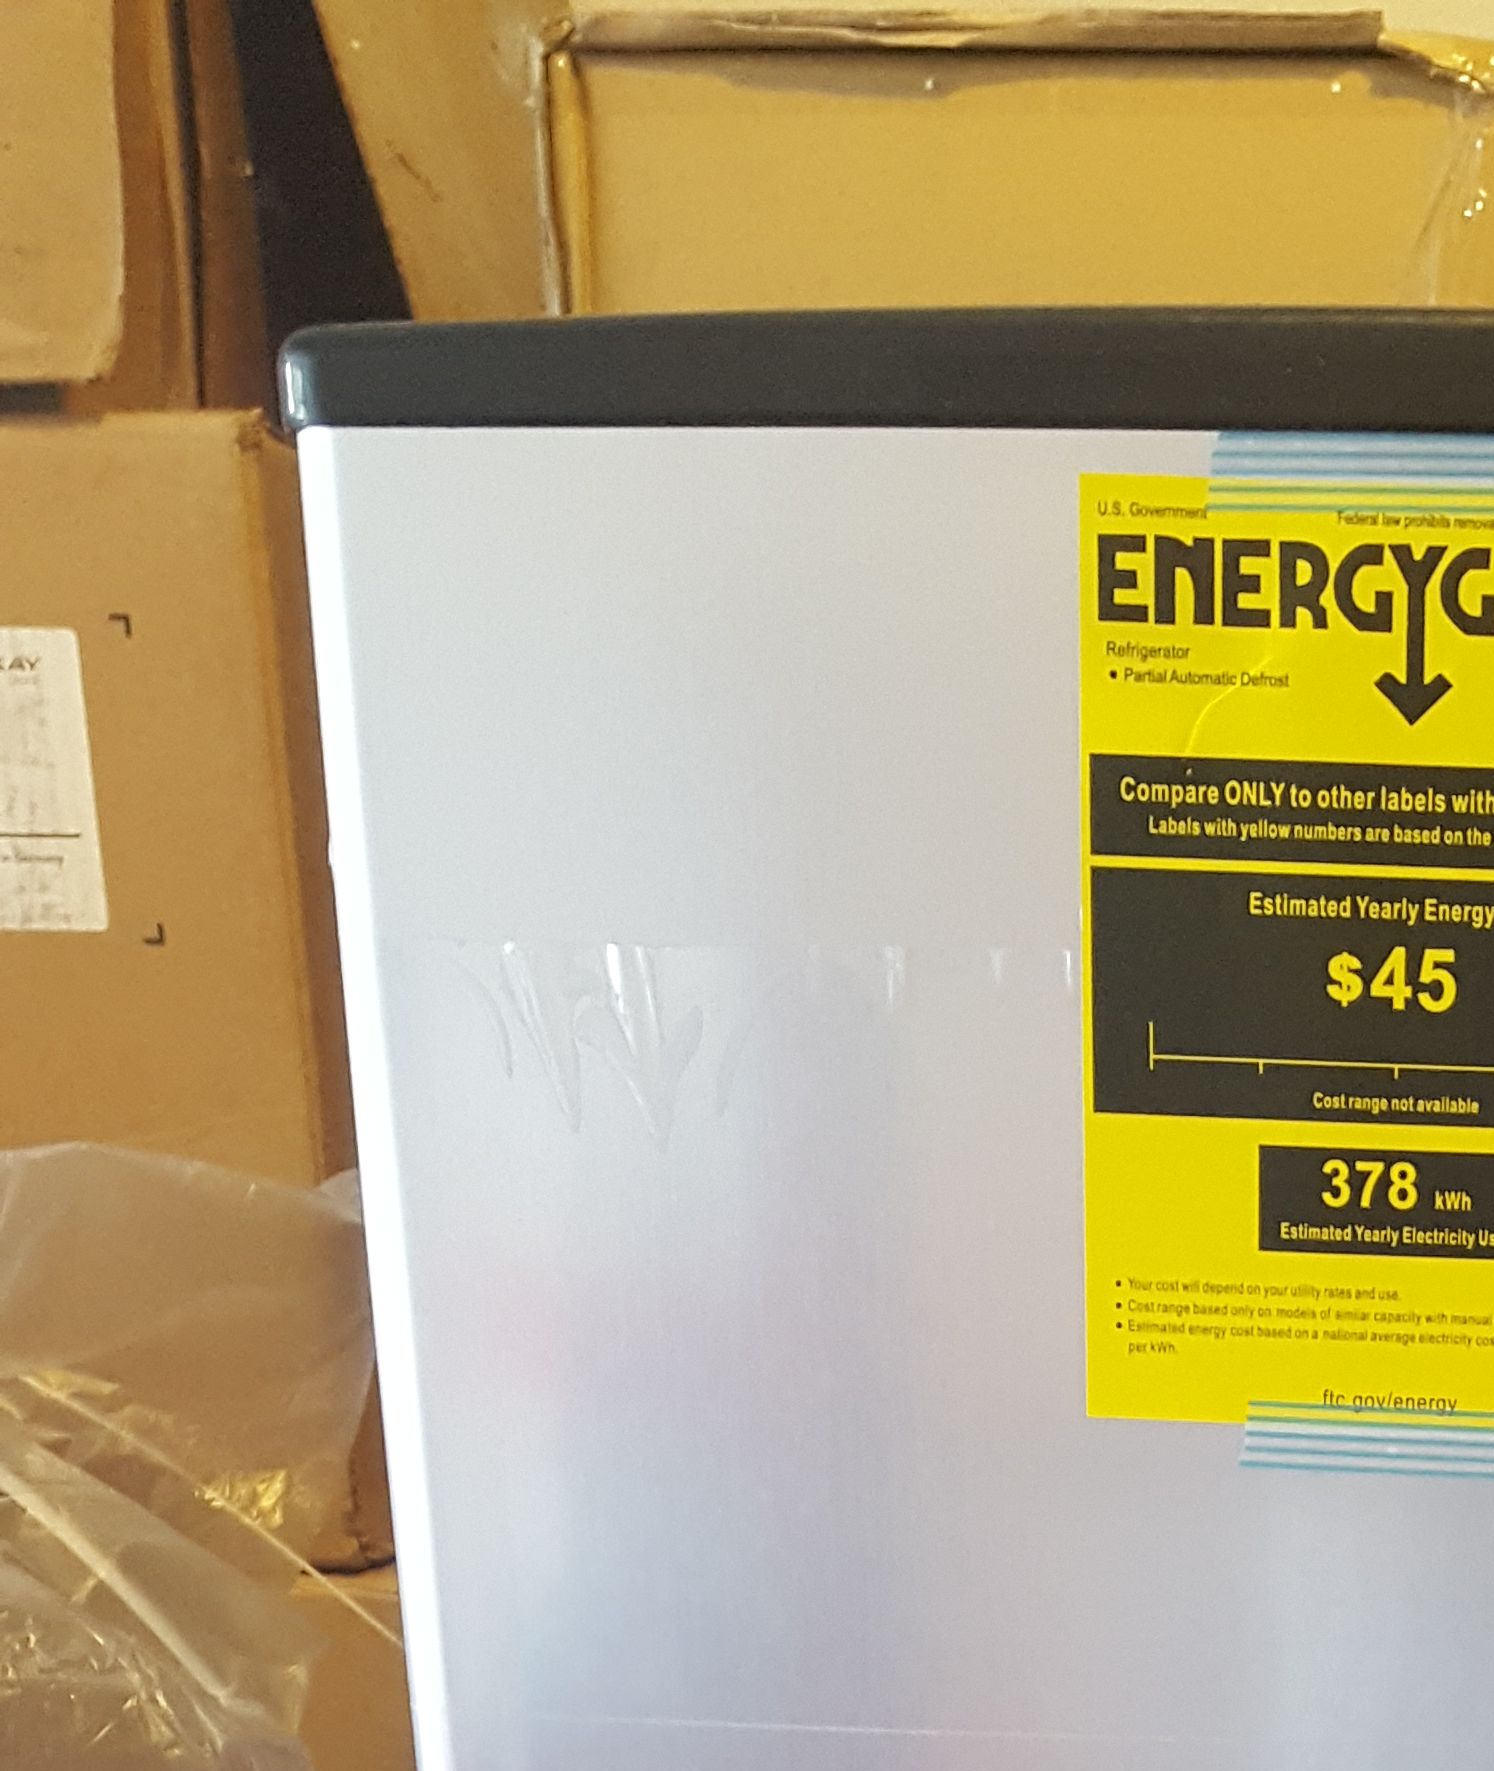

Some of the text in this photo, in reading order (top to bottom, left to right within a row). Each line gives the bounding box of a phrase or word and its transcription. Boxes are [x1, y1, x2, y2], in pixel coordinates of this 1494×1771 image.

[1097, 500, 1207, 519] U.S. Government
[1338, 511, 1379, 526] Federal
[1382, 513, 1401, 526] law
[1106, 641, 1190, 661] Refrigerator
[1123, 667, 1290, 687] Partial Automatic Defrost
[1120, 776, 1219, 808] Compare
[1224, 780, 1286, 807] ONLY
[1290, 784, 1311, 808] to
[1317, 784, 1375, 811] other
[1381, 786, 1446, 813] labels
[1148, 815, 1200, 836] Labels
[1203, 817, 1237, 838] with
[1240, 819, 1291, 842] yellow
[1293, 821, 1362, 843] numbers
[1365, 827, 1390, 843] are
[1393, 825, 1441, 846] based
[1443, 830, 1464, 846] on
[1466, 827, 1491, 847] the
[1249, 892, 1351, 918] Estimated
[1356, 896, 1419, 926] Yearly
[1326, 945, 1458, 1014] $45
[1312, 1092, 1480, 1115] Cost range not available
[1321, 1158, 1472, 1212] 378 kWh
[1279, 1221, 1351, 1242] Estimated
[1354, 1224, 1399, 1248] Yearly
[1402, 1226, 1476, 1250] Electricity
[1127, 1278, 1152, 1292] Your
[1155, 1280, 1180, 1293] cost
[1182, 1281, 1200, 1293] will
[1202, 1282, 1244, 1296] depend
[1246, 1284, 1261, 1296] on
[1263, 1286, 1288, 1299] your
[1290, 1285, 1321, 1301] utility
[1324, 1286, 1352, 1300] rates
[1354, 1288, 1376, 1300] and
[1127, 1299, 1493, 1326] Cost range based only on models of similar capacity with manual
[1127, 1319, 1185, 1335] Estimated
[1188, 1323, 1227, 1340] energy
[1230, 1325, 1254, 1337] cost
[1257, 1325, 1293, 1339] based
[1294, 1328, 1309, 1339] on
[1311, 1329, 1319, 1340] a
[1322, 1327, 1368, 1342] national
[1370, 1331, 1416, 1346] average
[1418, 1331, 1472, 1348] electricity
[1127, 1341, 1148, 1355] per
